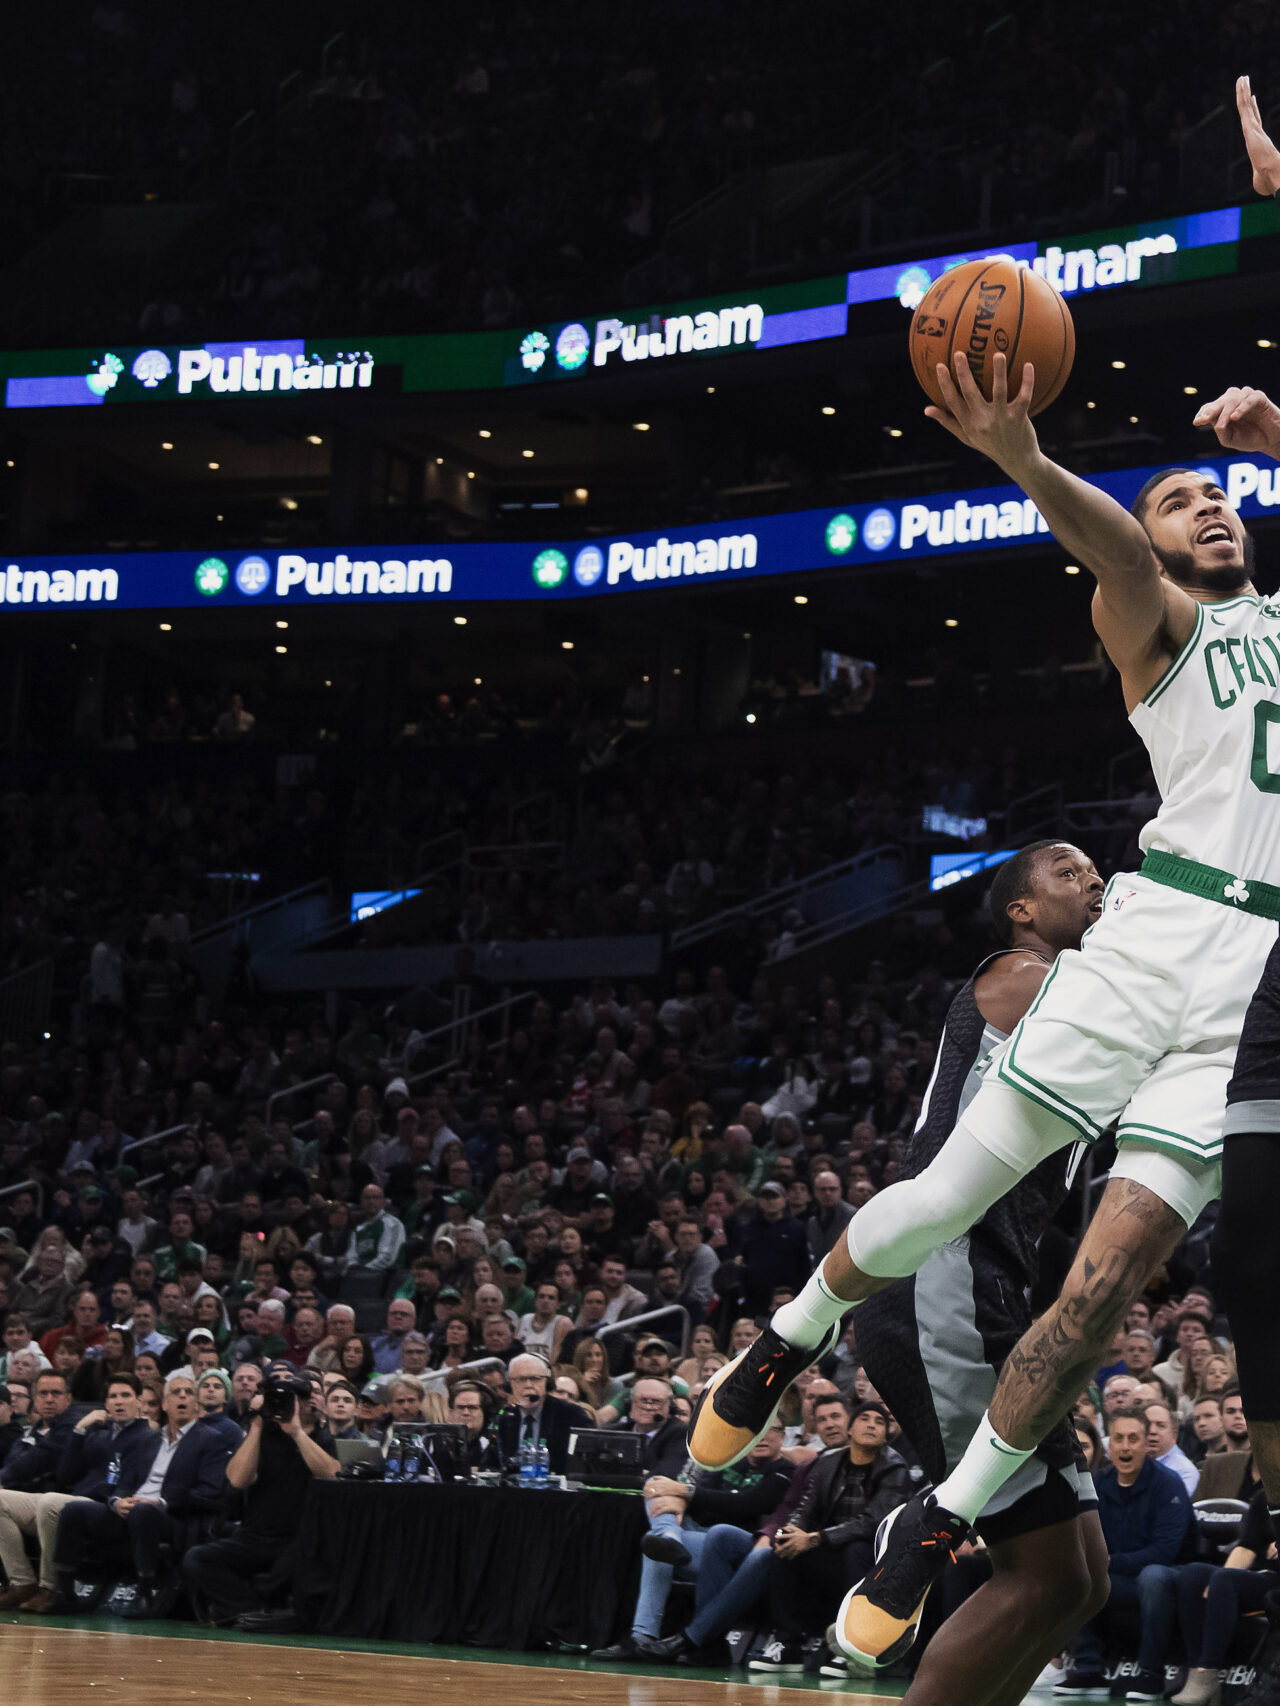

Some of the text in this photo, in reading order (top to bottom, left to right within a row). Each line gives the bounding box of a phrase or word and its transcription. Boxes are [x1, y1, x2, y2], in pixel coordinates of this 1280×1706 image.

[593, 303, 764, 366] Putnam
[276, 555, 452, 596] Putnam
[607, 534, 757, 585] Putnam
